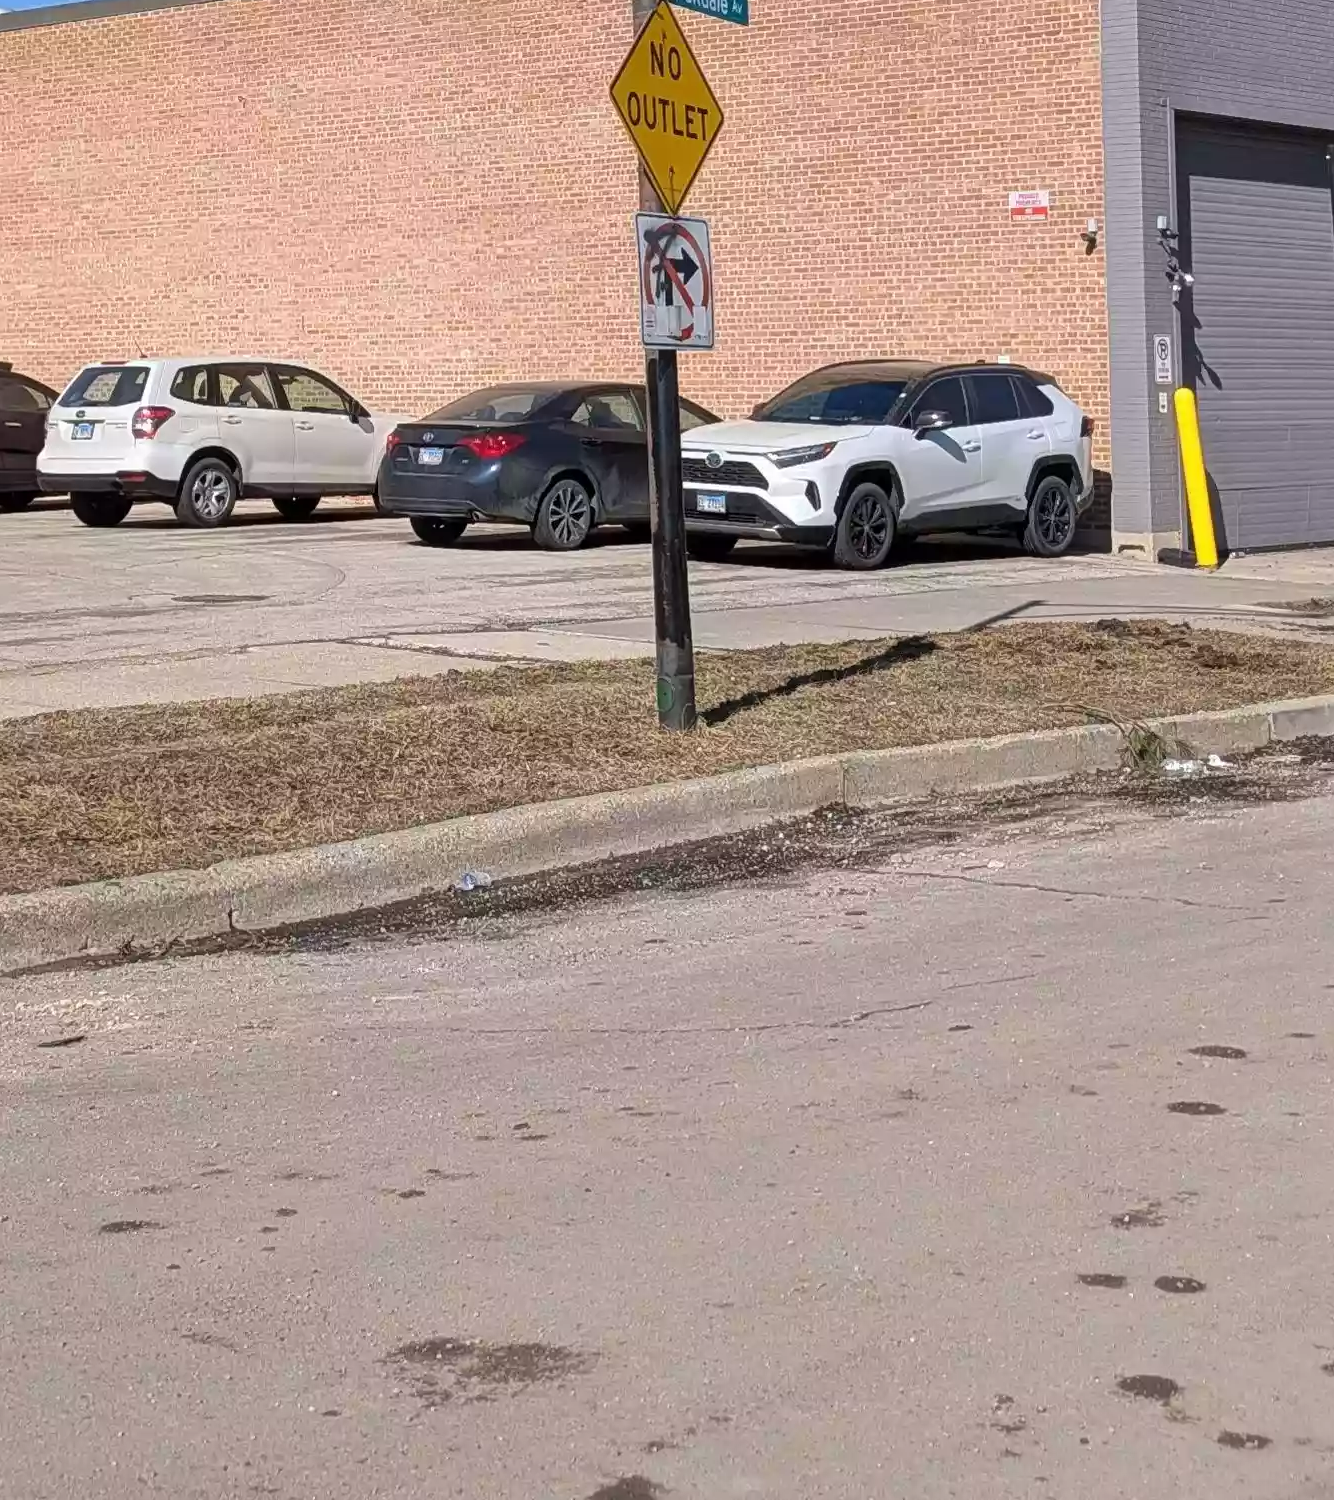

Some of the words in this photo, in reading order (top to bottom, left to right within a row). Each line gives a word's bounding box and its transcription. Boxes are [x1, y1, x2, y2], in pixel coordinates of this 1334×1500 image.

[731, 0, 743, 15] Av
[650, 40, 681, 81] NO
[627, 91, 709, 141] OUTLET
